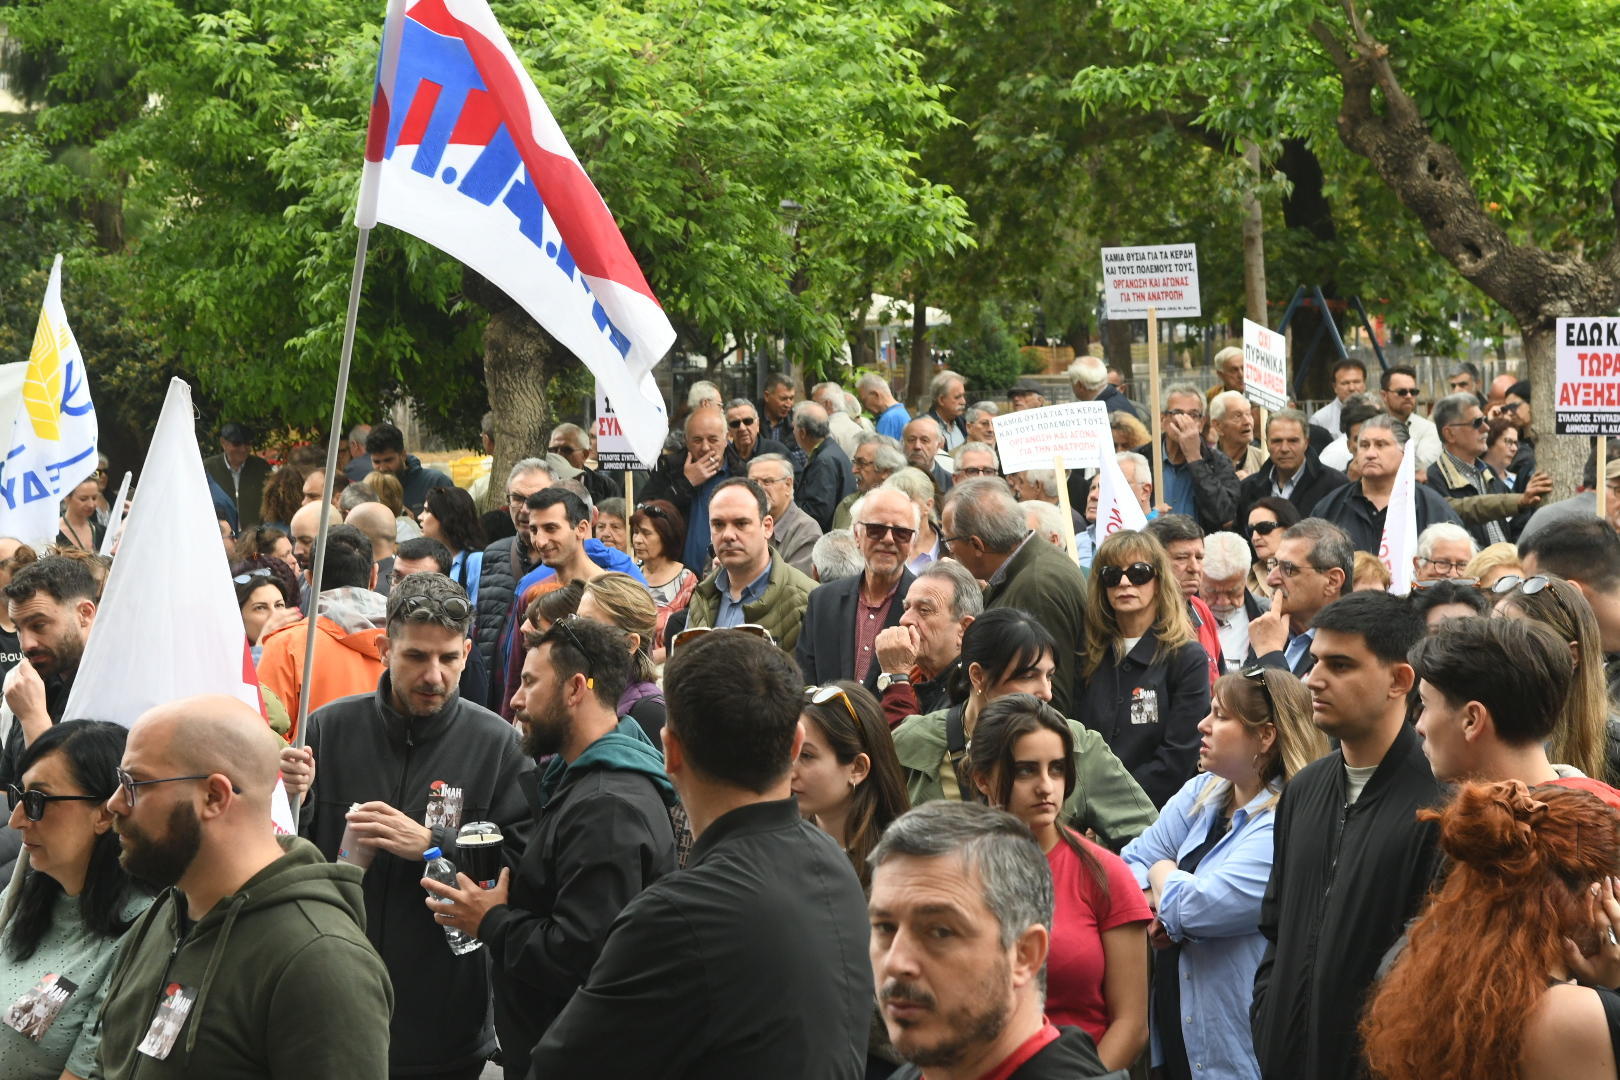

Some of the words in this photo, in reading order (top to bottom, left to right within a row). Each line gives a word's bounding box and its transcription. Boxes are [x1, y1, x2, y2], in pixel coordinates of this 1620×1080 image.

[1105, 252, 1124, 262] ΚΑΜΙΑ
[1126, 252, 1146, 261] ΘΥΣΙΑ
[1147, 251, 1158, 261] ΓΙΑ
[1159, 250, 1168, 260] ΤΑ
[1170, 249, 1193, 259] ΚΕΡΔΗ
[1106, 266, 1116, 275] ΚΑΙ
[1118, 265, 1135, 275] ΤΟΥΣ
[1136, 264, 1173, 274] ΠΟΛΕΜΟΥΣ
[1113, 279, 1147, 289] ΟΡΓΑΝΩΣΗ
[1149, 278, 1161, 288] ΚΑΙ
[1162, 276, 1189, 287] ΑΓΩΝΑΣ
[1120, 292, 1130, 302] ΓΙΑ
[1132, 292, 1146, 302] ΤΗΝ
[1147, 290, 1184, 301] ΑΝΑΤΡΟΠΗ
[1258, 331, 1271, 350] ΟΧΙ
[1566, 322, 1602, 346] ΕΔΩ
[1607, 323, 1620, 346] Κ
[1246, 344, 1283, 375] ΠΥΡΗΝΙΚΑ
[1246, 363, 1262, 385] ΣΤΟΝ
[1264, 370, 1284, 394] ΑΡΑΞΟ
[998, 417, 1022, 428] ΚΑΜΙΑ
[1050, 410, 1062, 418] ΓΙΑ
[1065, 408, 1075, 416] ΤΑ
[1077, 406, 1103, 415] ΚΕΡΔΗ
[1558, 414, 1590, 422] ΣΥΛΛΟΓΟΣ
[999, 429, 1012, 438] ΚΑΙ
[1015, 424, 1035, 434] ΤΟΥΣ
[1037, 419, 1081, 430] ΠΟΛΕΜΟΥΣ
[1566, 424, 1599, 433] ΔΗΜΟΣΙΟΥ
[1010, 434, 1052, 447] ΟΡΓΑΝΩΣΗ
[1054, 431, 1068, 440] ΚΑΙ
[1019, 448, 1032, 456] ΓΙΑ
[1035, 444, 1050, 453] ΤΗΝ
[1053, 442, 1096, 452] ΑΝΑΤΡΟΠΗ
[0, 651, 25, 662] Bau
